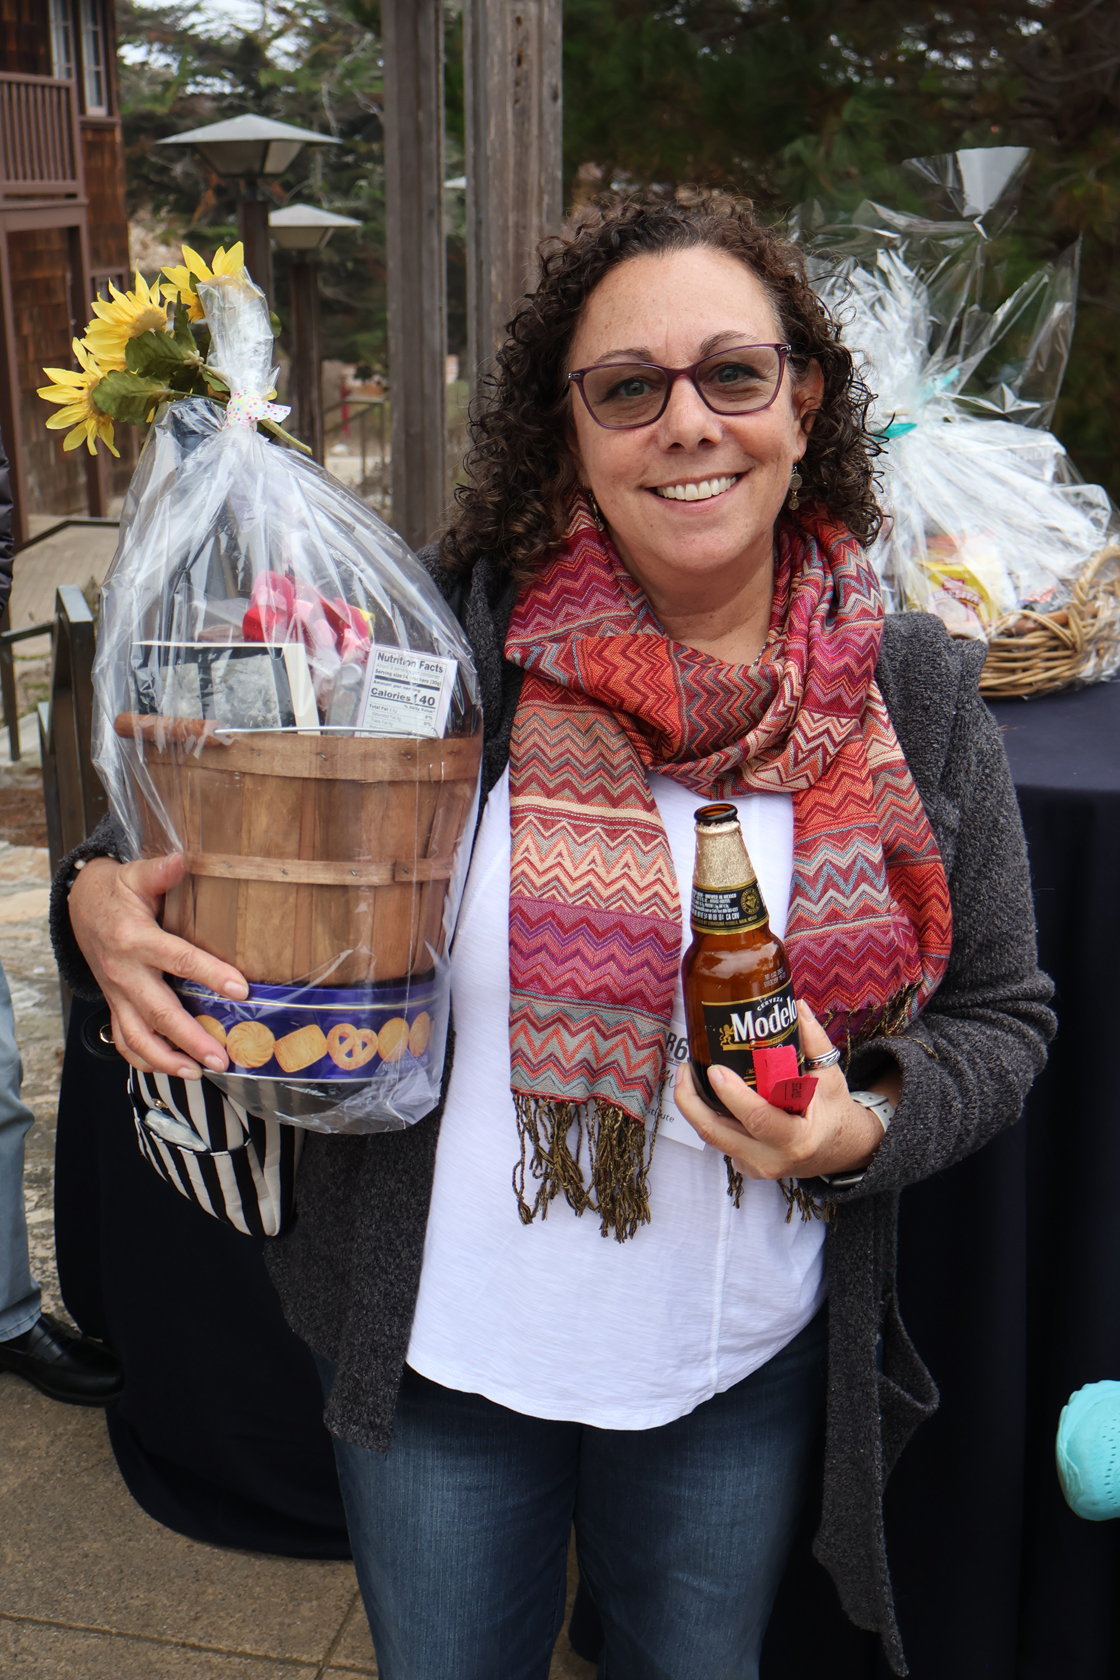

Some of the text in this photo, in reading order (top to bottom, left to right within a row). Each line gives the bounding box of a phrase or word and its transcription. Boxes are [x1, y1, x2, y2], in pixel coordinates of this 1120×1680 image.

[377, 652, 444, 674] Nutrition Facts
[375, 668, 393, 677] Serving
[372, 679, 392, 687] Amount
[403, 685, 421, 693] sering
[371, 687, 436, 706] Calories 140
[732, 912, 740, 920] CRV
[756, 996, 783, 1012] CERVEZA
[729, 995, 798, 1043] Modelo
[666, 1031, 689, 1063] R6
